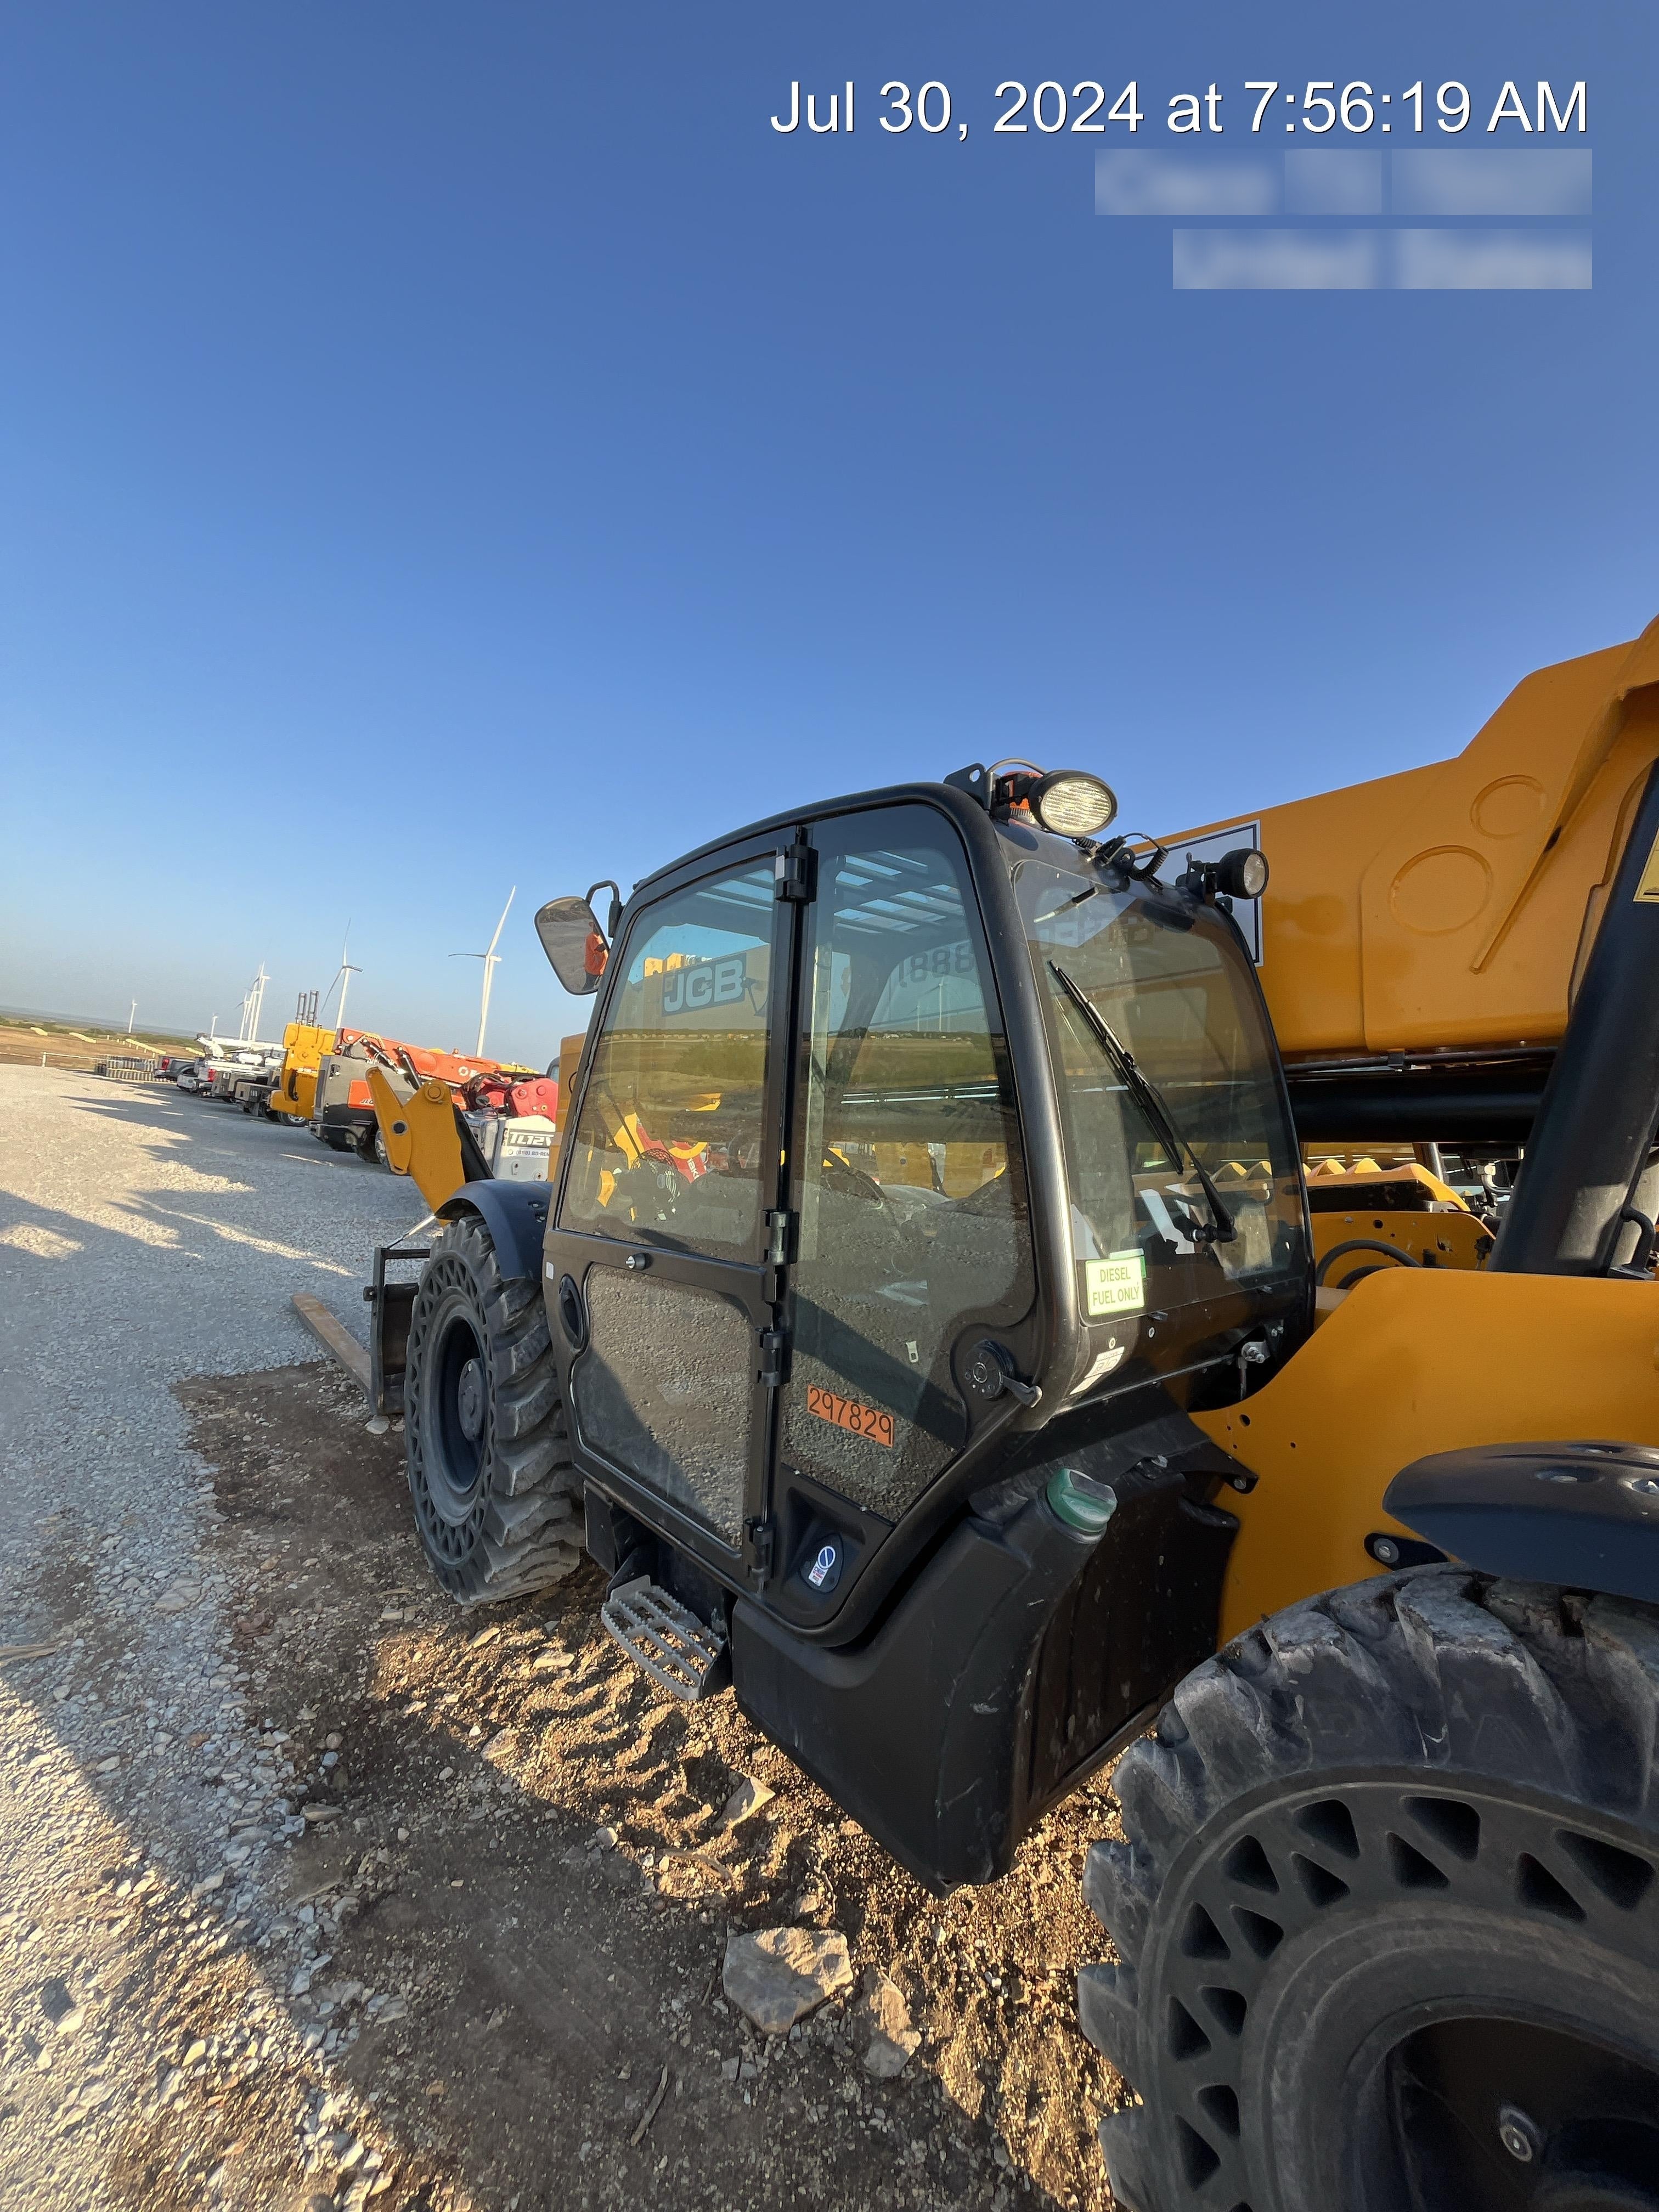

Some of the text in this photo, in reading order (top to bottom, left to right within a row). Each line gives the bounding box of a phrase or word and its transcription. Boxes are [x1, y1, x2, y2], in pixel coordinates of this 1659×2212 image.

[664, 960, 743, 1012] JCB
[1099, 1266, 1131, 1283] DIESEL
[1092, 1286, 1139, 1306] FUEL ONLY
[809, 1387, 891, 1444] 297829
